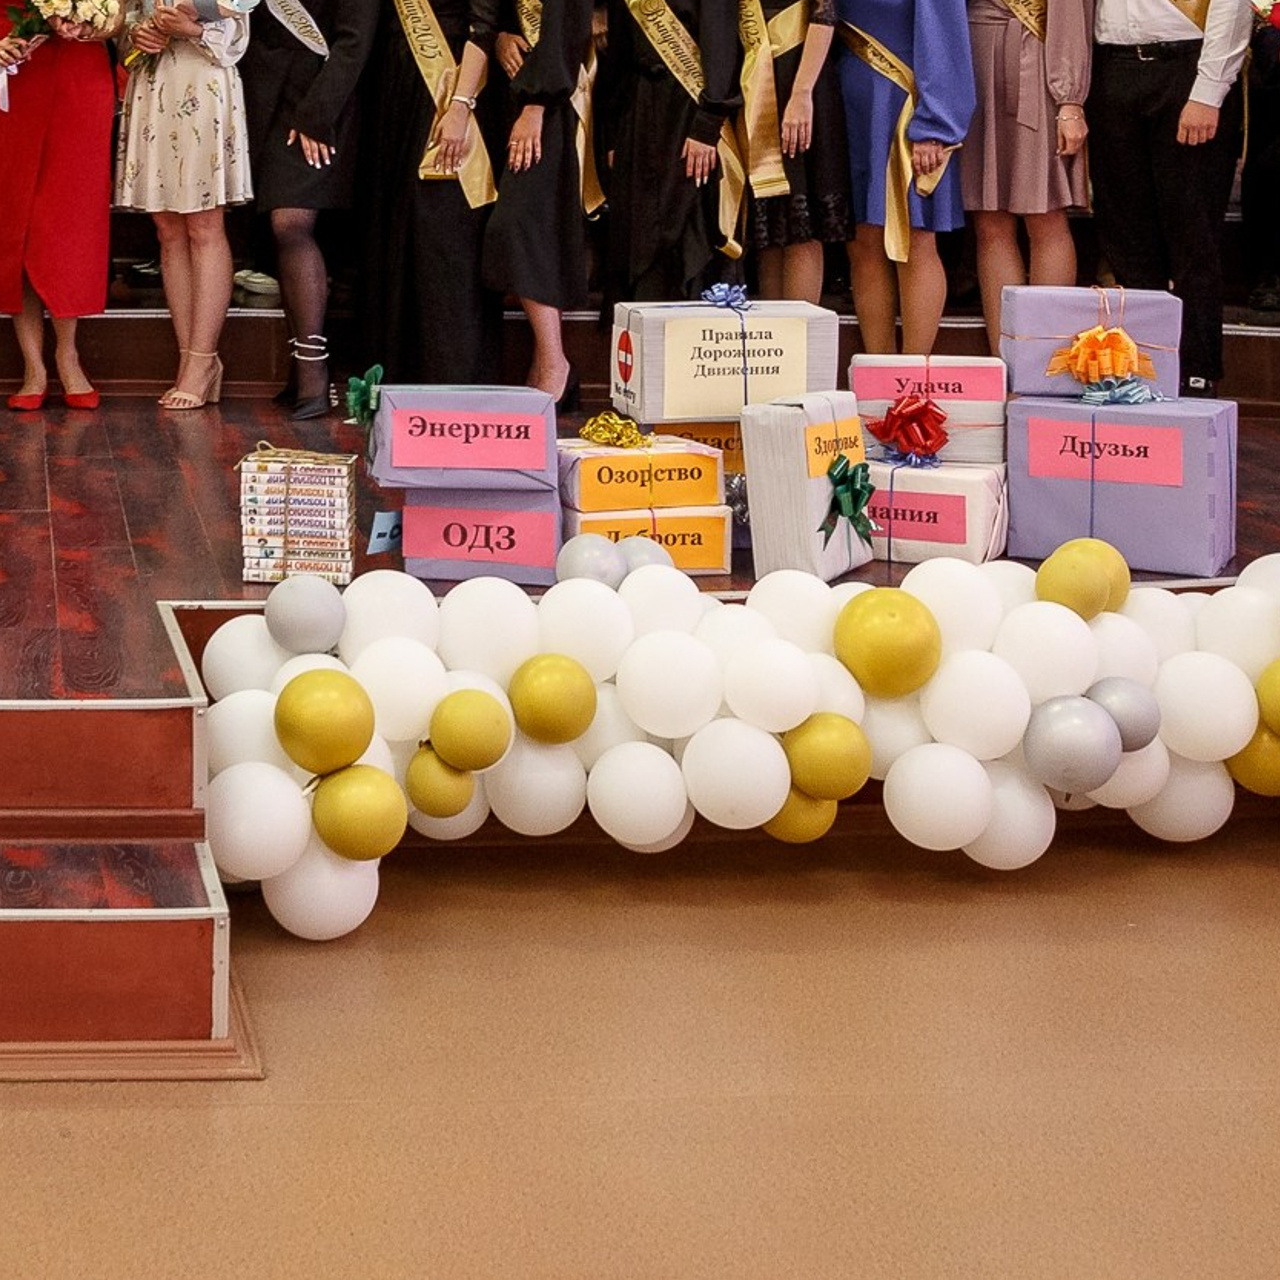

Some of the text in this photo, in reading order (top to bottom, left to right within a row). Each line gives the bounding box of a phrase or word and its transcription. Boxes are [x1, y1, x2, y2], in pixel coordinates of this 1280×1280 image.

[701, 328, 773, 343] Правила
[690, 346, 784, 362] Дорожного
[694, 364, 780, 379] Движения
[894, 377, 964, 396] Удача
[408, 415, 531, 444] Энергия
[814, 435, 859, 457] Здоровье
[1060, 435, 1149, 460] Друзья
[597, 465, 703, 487] Озорство
[443, 522, 516, 554] ОДЗ
